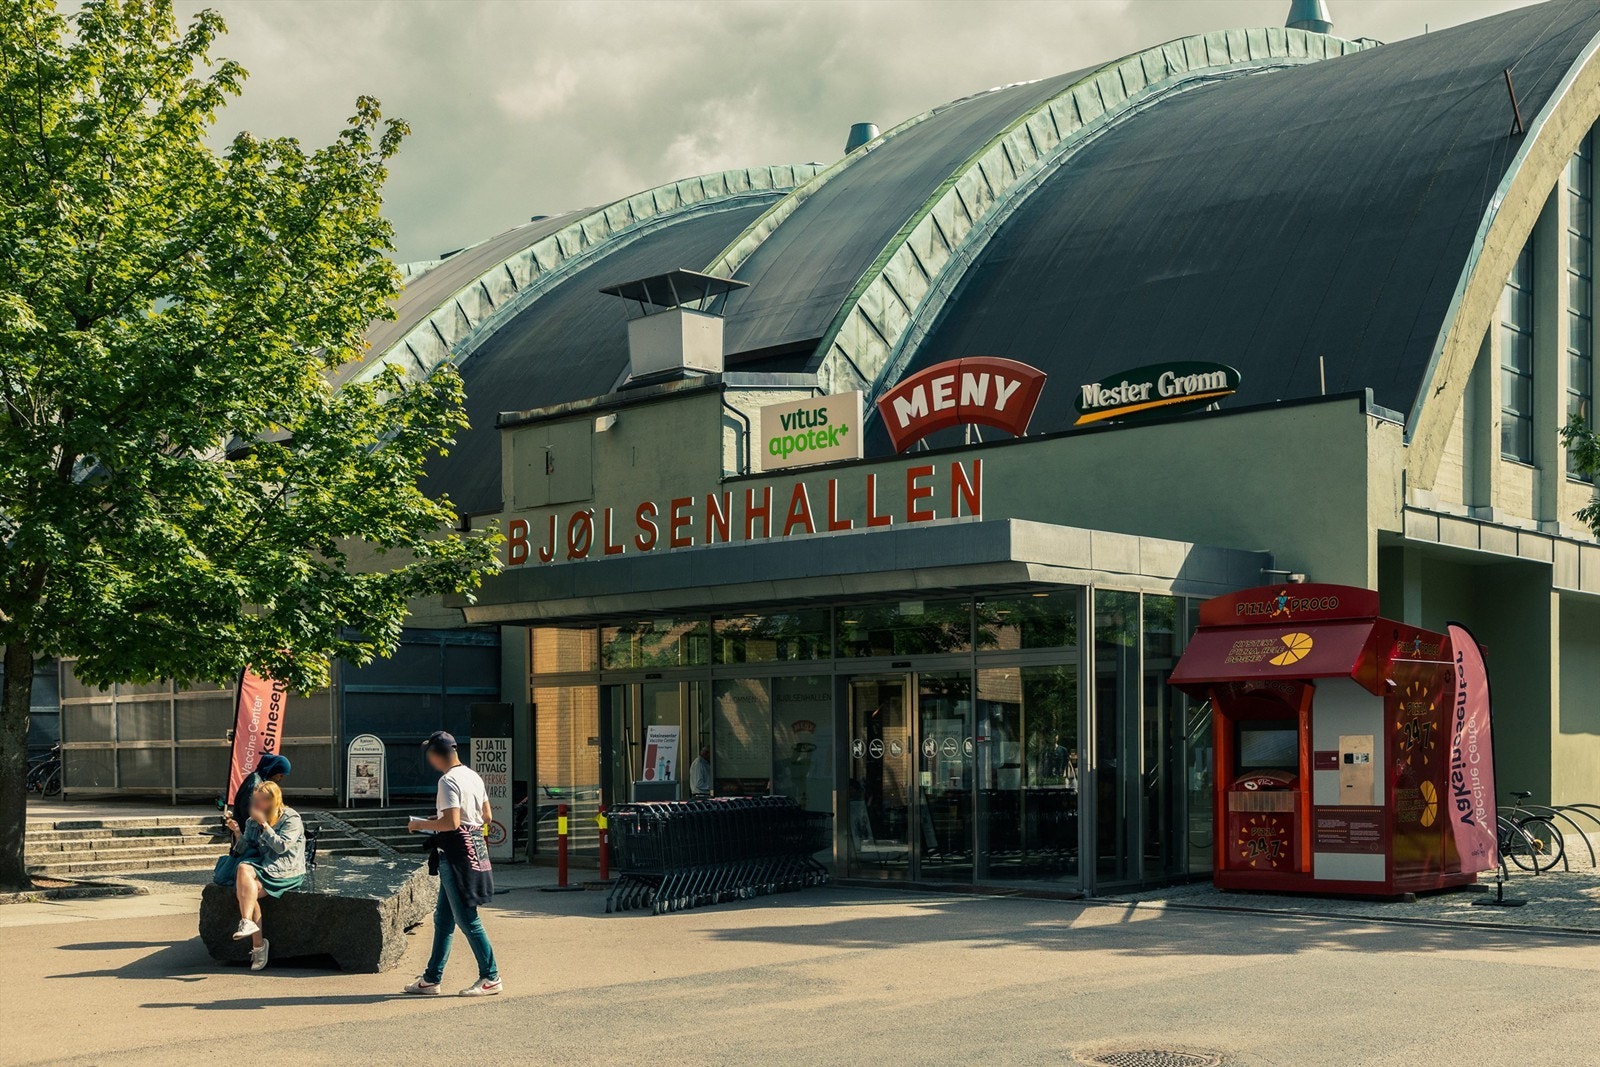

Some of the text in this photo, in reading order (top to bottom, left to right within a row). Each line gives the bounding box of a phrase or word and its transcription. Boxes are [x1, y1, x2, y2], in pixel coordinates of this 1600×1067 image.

[892, 372, 1022, 428] MENY
[1081, 370, 1228, 409] Mester Grønn
[780, 407, 828, 431] vitus
[508, 458, 984, 566] BJØLSENHALLEN
[1237, 596, 1339, 616] PIZZA PROCO
[242, 696, 262, 776] Vaccine Center
[476, 740, 506, 750] SI JA TIL
[476, 751, 507, 762] STORT
[476, 763, 507, 773] UTVALG
[484, 774, 506, 785] FERSKE
